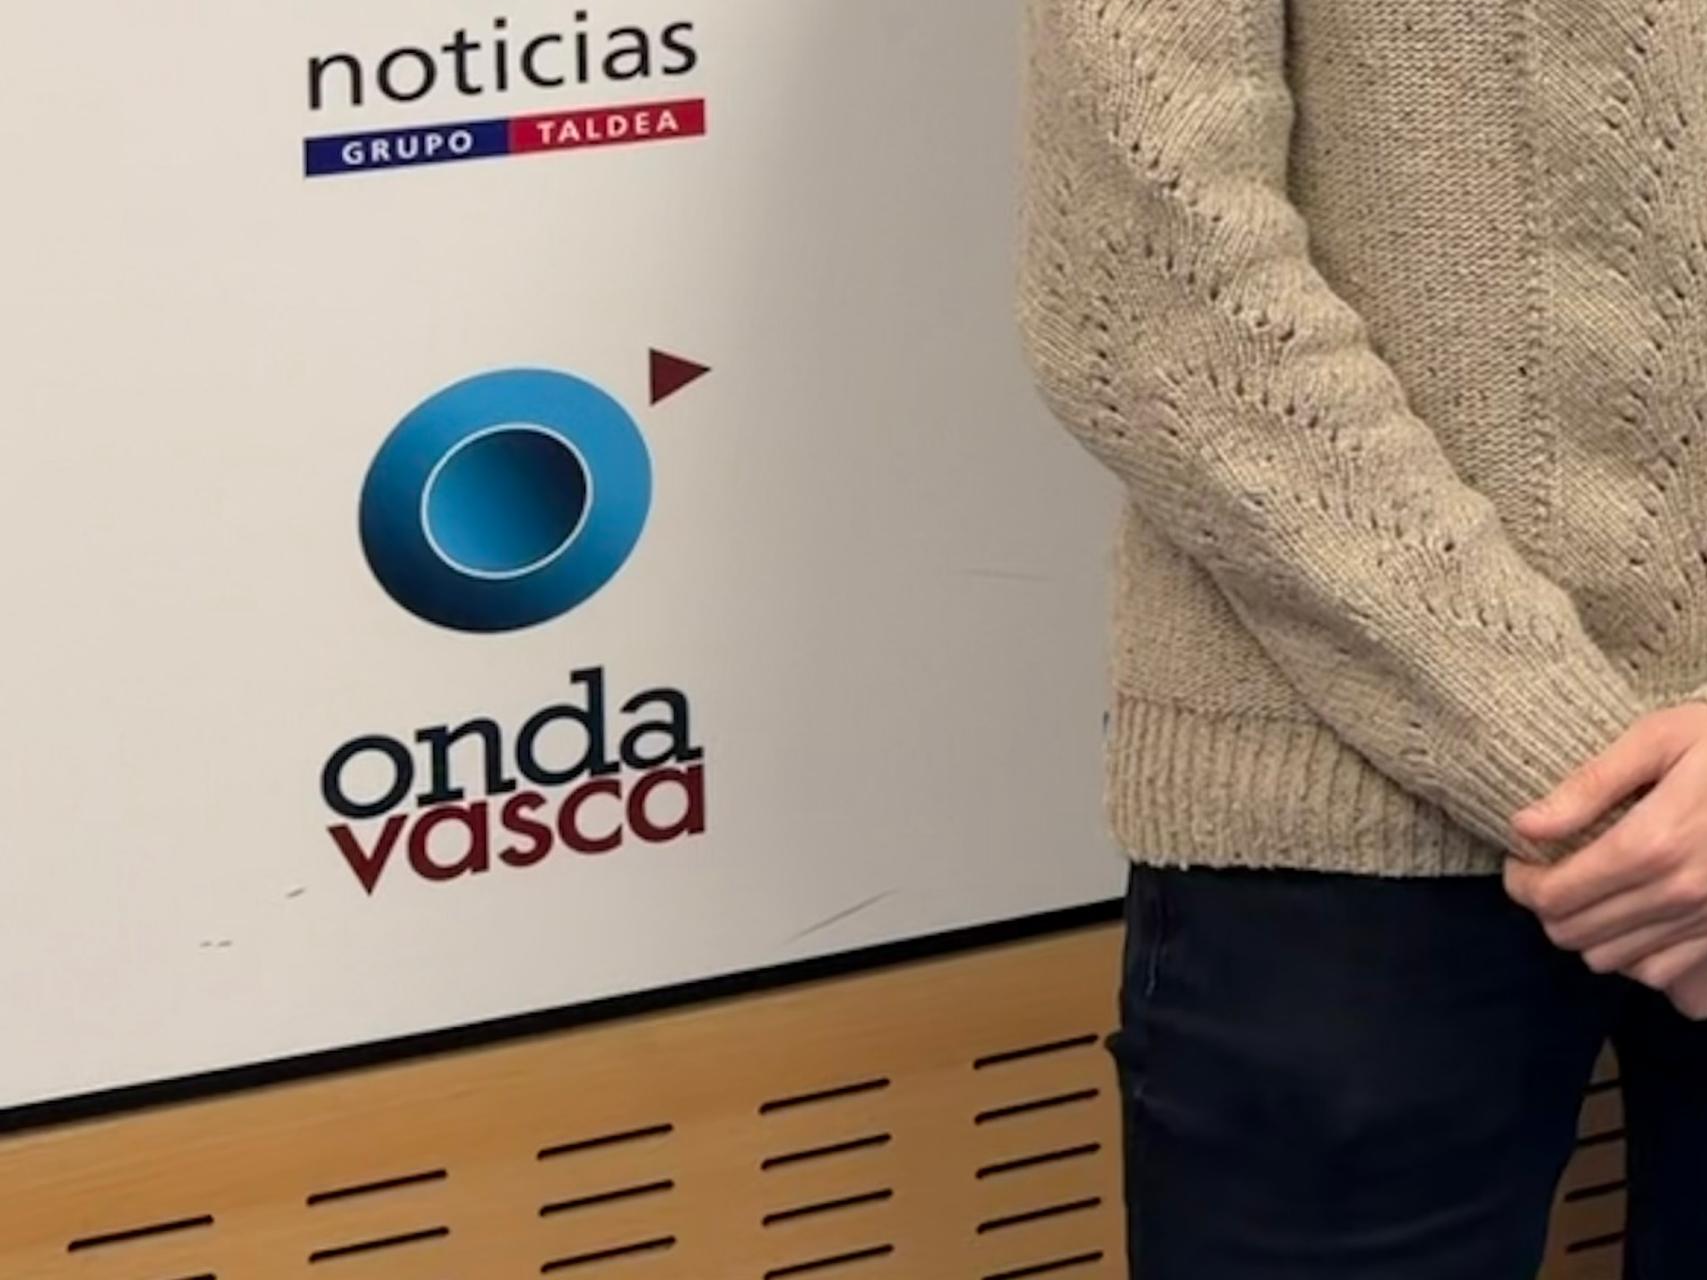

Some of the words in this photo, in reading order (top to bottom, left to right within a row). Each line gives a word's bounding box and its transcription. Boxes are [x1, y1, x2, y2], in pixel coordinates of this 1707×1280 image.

[308, 10, 698, 110] noticias
[342, 130, 472, 166] GRUPO
[537, 110, 679, 144] TALDEA
[320, 665, 704, 819] onda
[327, 764, 705, 897] vasca
